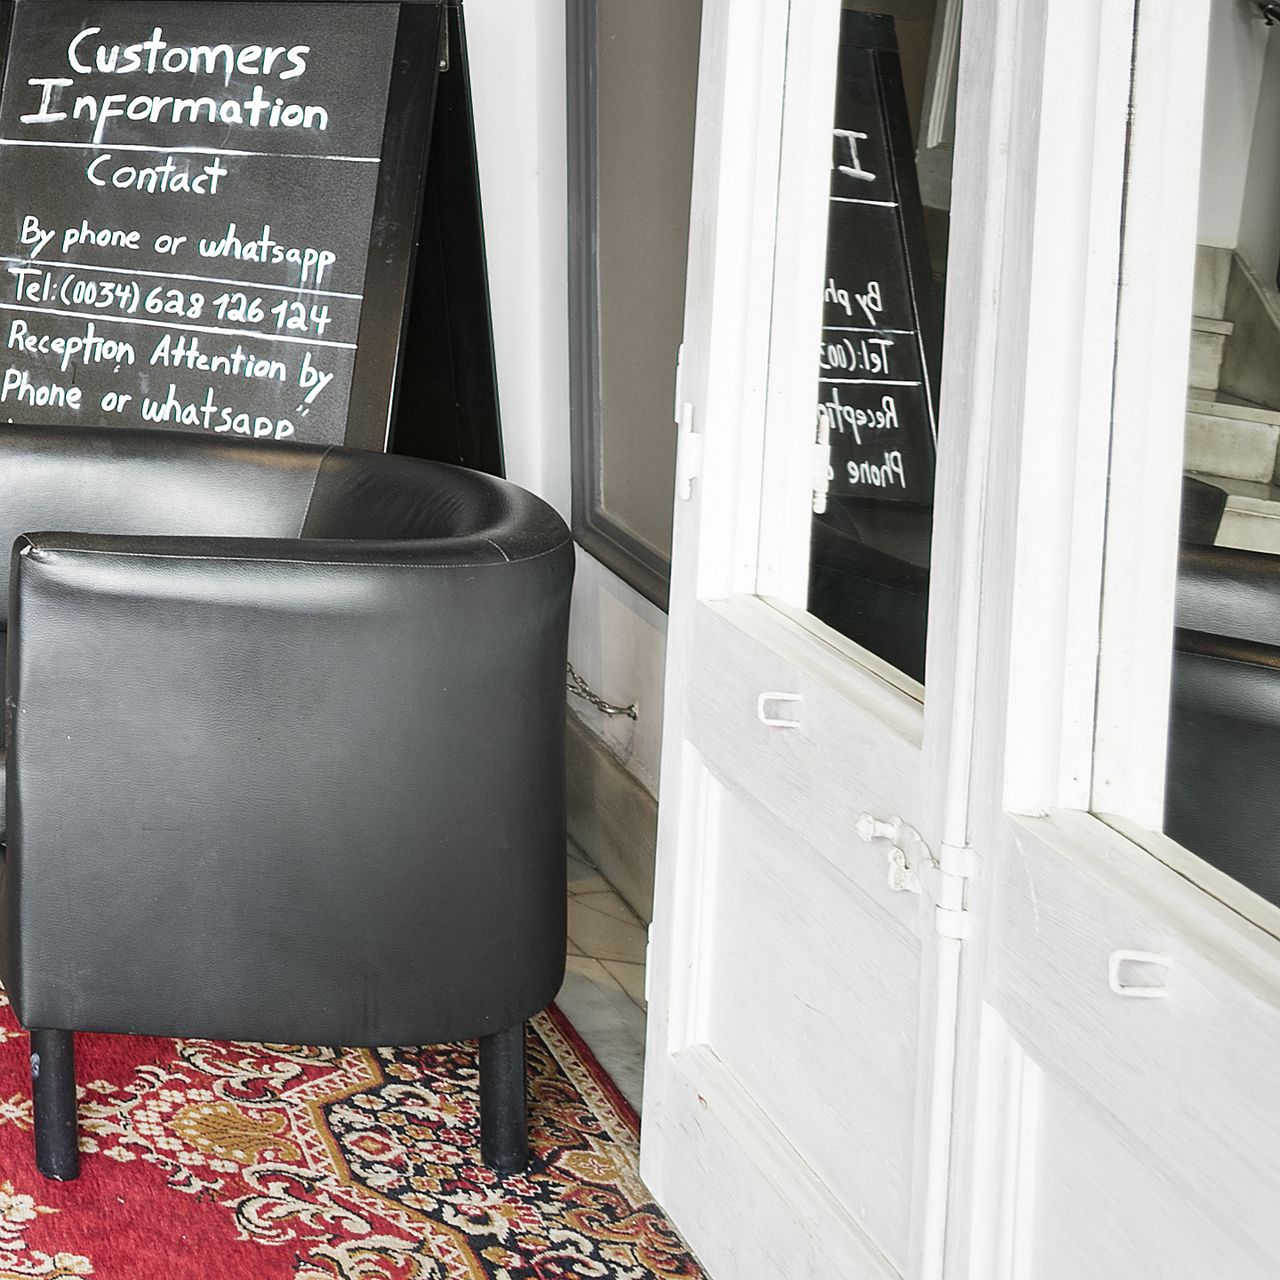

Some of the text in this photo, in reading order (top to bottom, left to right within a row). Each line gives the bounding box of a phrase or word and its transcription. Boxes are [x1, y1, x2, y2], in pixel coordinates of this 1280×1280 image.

[67, 26, 311, 83] Customers
[86, 154, 228, 195] Contact
[20, 215, 336, 283] By phone or whatsapp
[144, 289, 204, 319] 628
[212, 292, 265, 322] 126
[271, 297, 332, 335] 124
[7, 319, 334, 404] Reception Attention by
[0, 368, 82, 409] Phone
[101, 391, 132, 414] or
